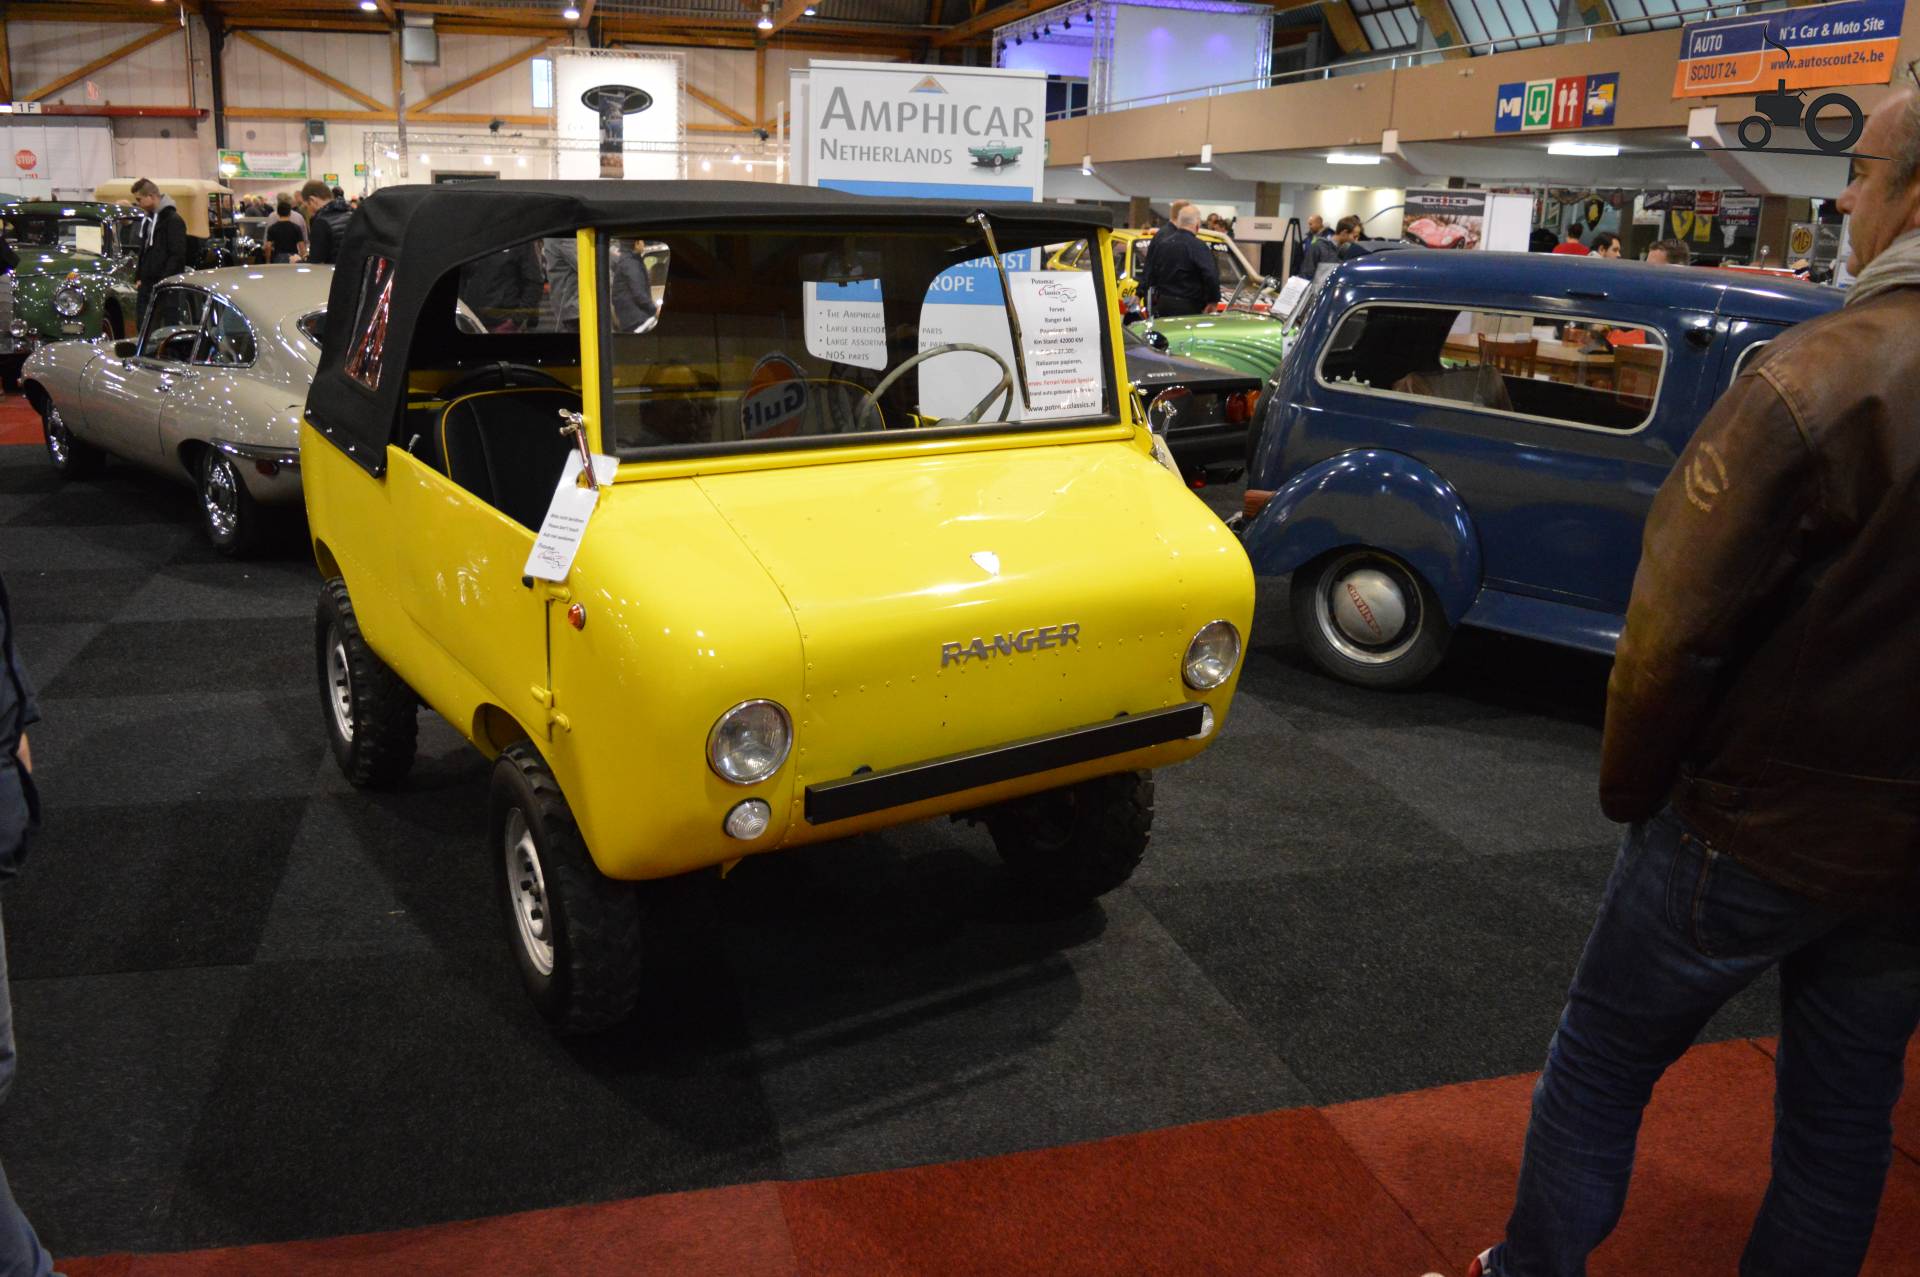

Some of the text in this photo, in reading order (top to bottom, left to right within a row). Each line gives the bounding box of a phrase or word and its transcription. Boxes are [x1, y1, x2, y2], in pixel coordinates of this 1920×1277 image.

[1800, 25, 1817, 39] Car
[1821, 23, 1830, 37] &
[1832, 20, 1860, 36] Moto
[1863, 16, 1885, 32] Site
[1693, 34, 1723, 53] AUTO
[1770, 49, 1885, 71] www.autoscout24.be
[929, 275, 975, 292] ROPE
[1122, 286, 1134, 297] elf
[940, 622, 1080, 669] RANGER
